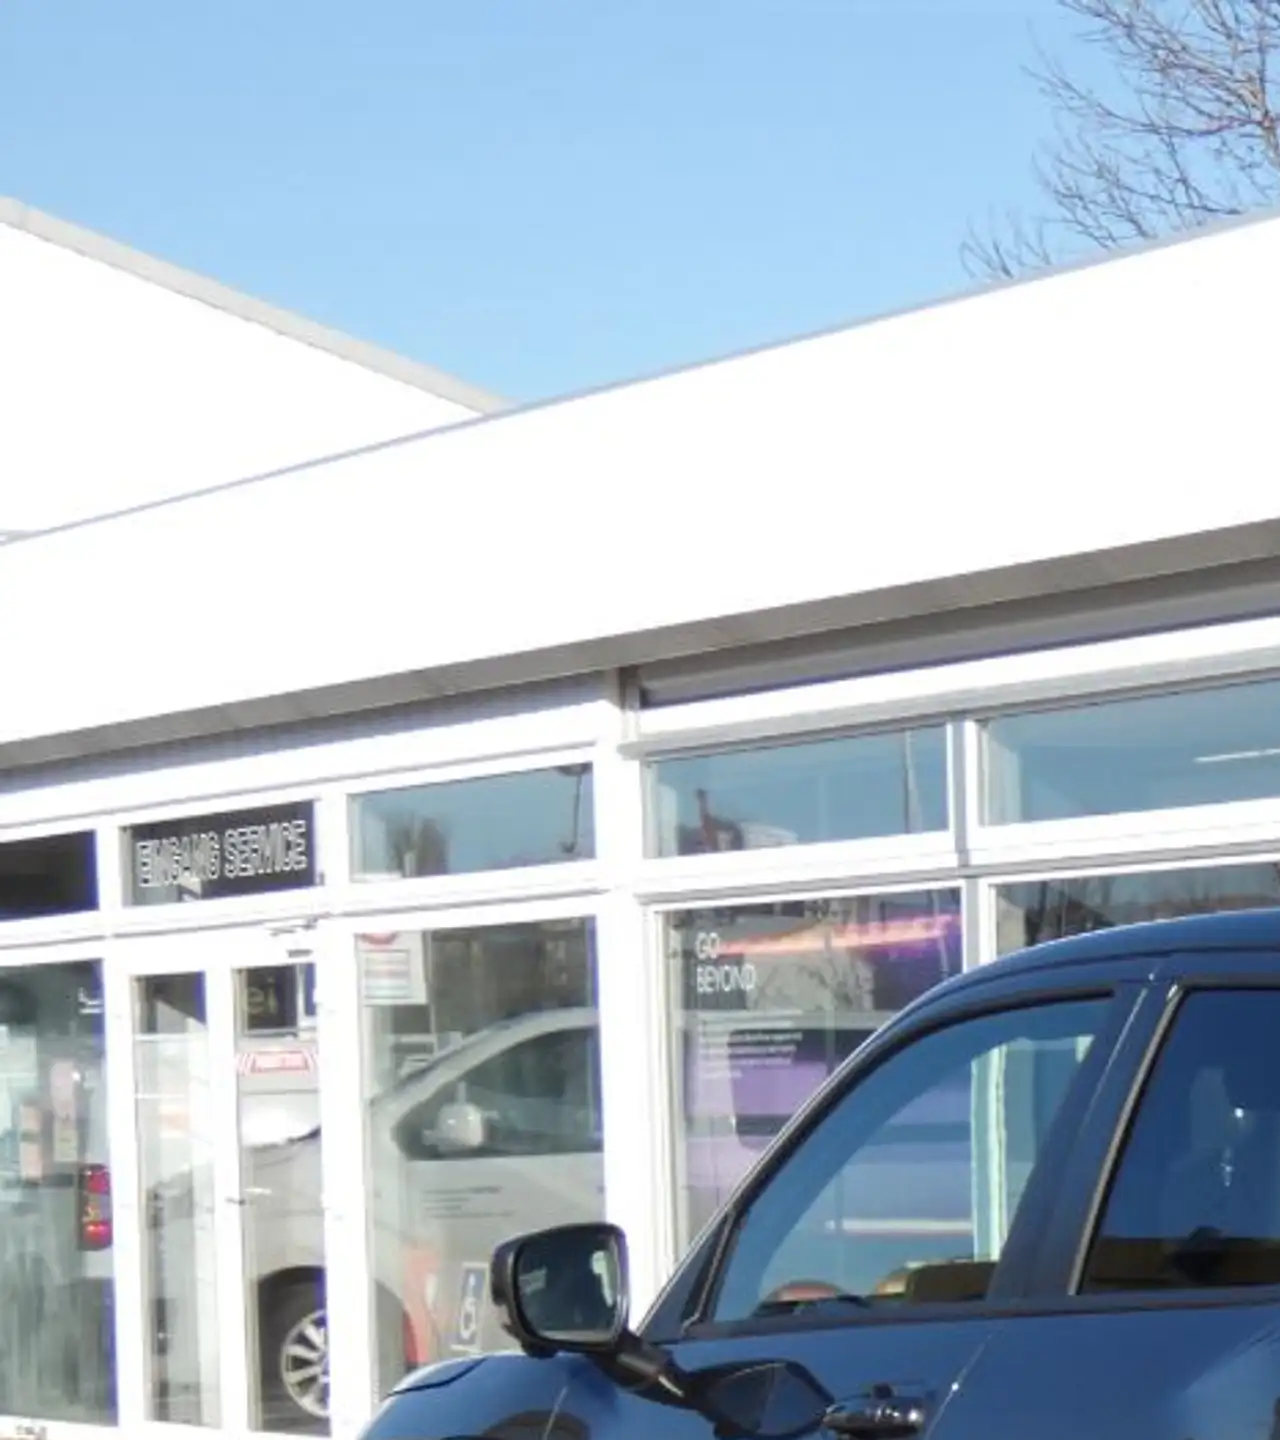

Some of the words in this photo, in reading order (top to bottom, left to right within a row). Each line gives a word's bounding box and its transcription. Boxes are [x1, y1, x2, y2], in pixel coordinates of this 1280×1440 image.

[136, 831, 220, 887] EINGANG
[224, 820, 308, 879] SERVICE
[695, 931, 721, 960] GO
[696, 963, 757, 994] BEYOND
